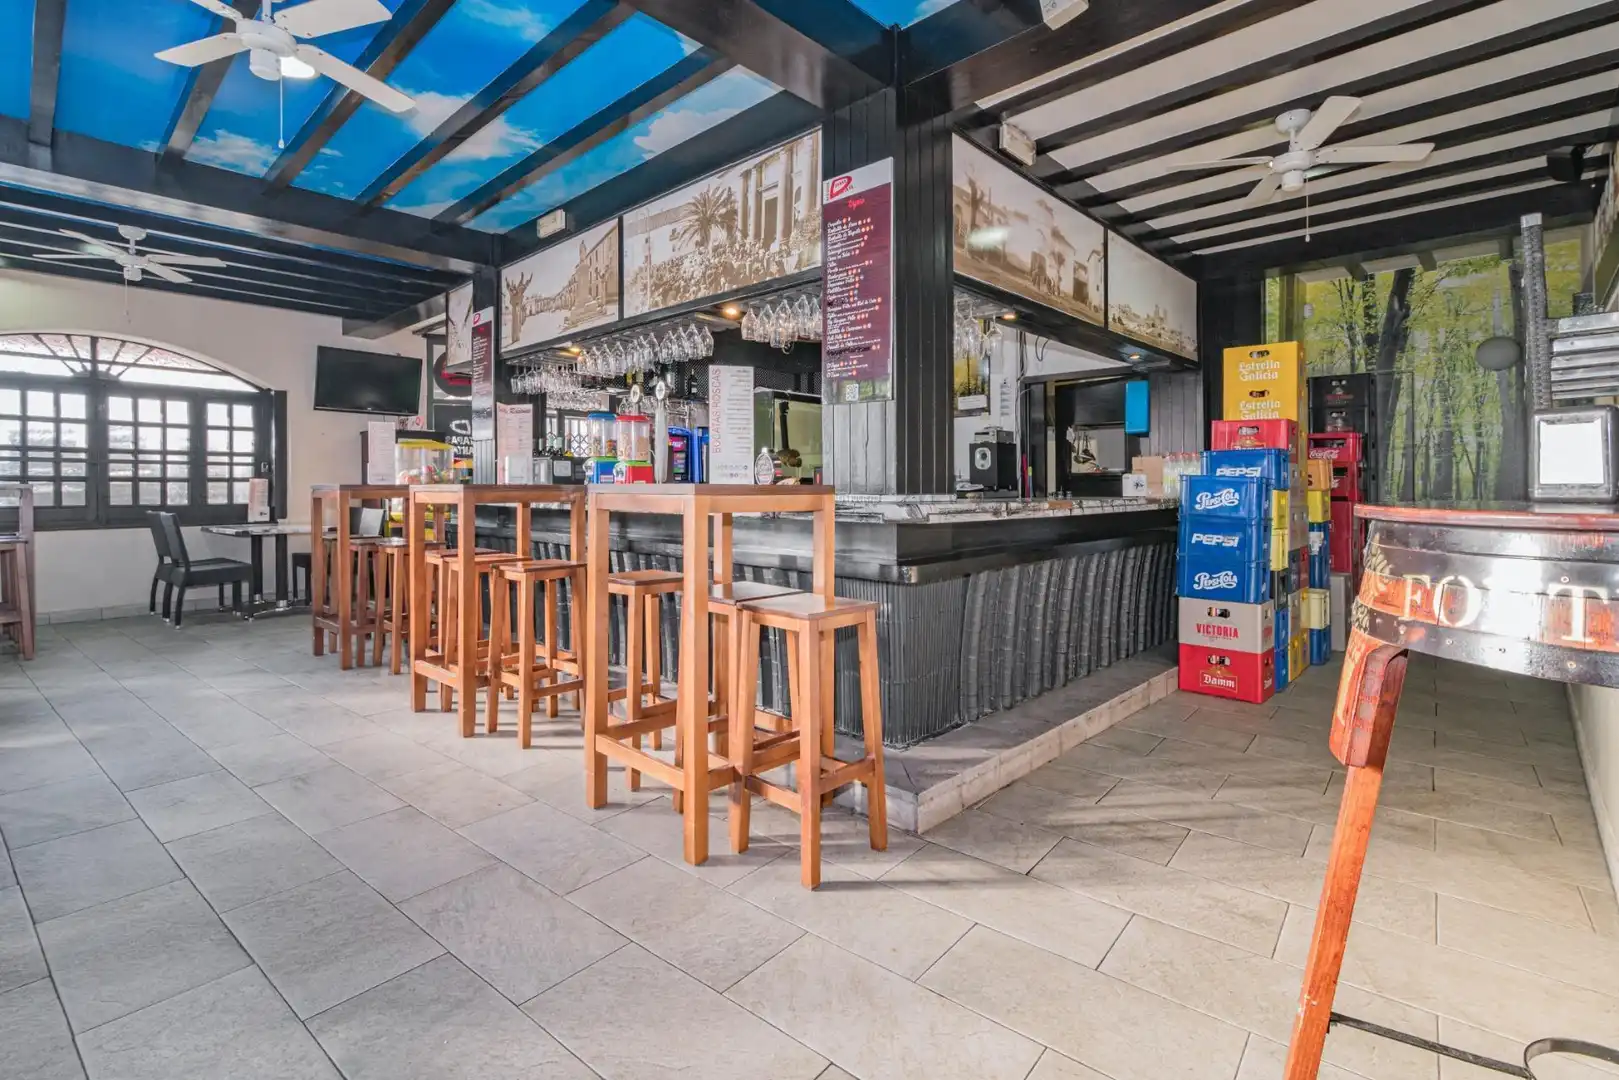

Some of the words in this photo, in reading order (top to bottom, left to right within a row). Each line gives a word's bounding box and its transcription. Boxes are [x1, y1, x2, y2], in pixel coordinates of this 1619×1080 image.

[1239, 360, 1280, 371] Estrella
[1240, 371, 1278, 381] Galicia
[1240, 401, 1280, 411] Estrella
[1241, 410, 1279, 420] Galicia
[1215, 467, 1261, 477] PEPSI
[1191, 533, 1239, 547] PEPSI
[1398, 574, 1609, 643] FOT
[1196, 623, 1239, 638] VICTORIA
[1203, 674, 1235, 688] Damm
